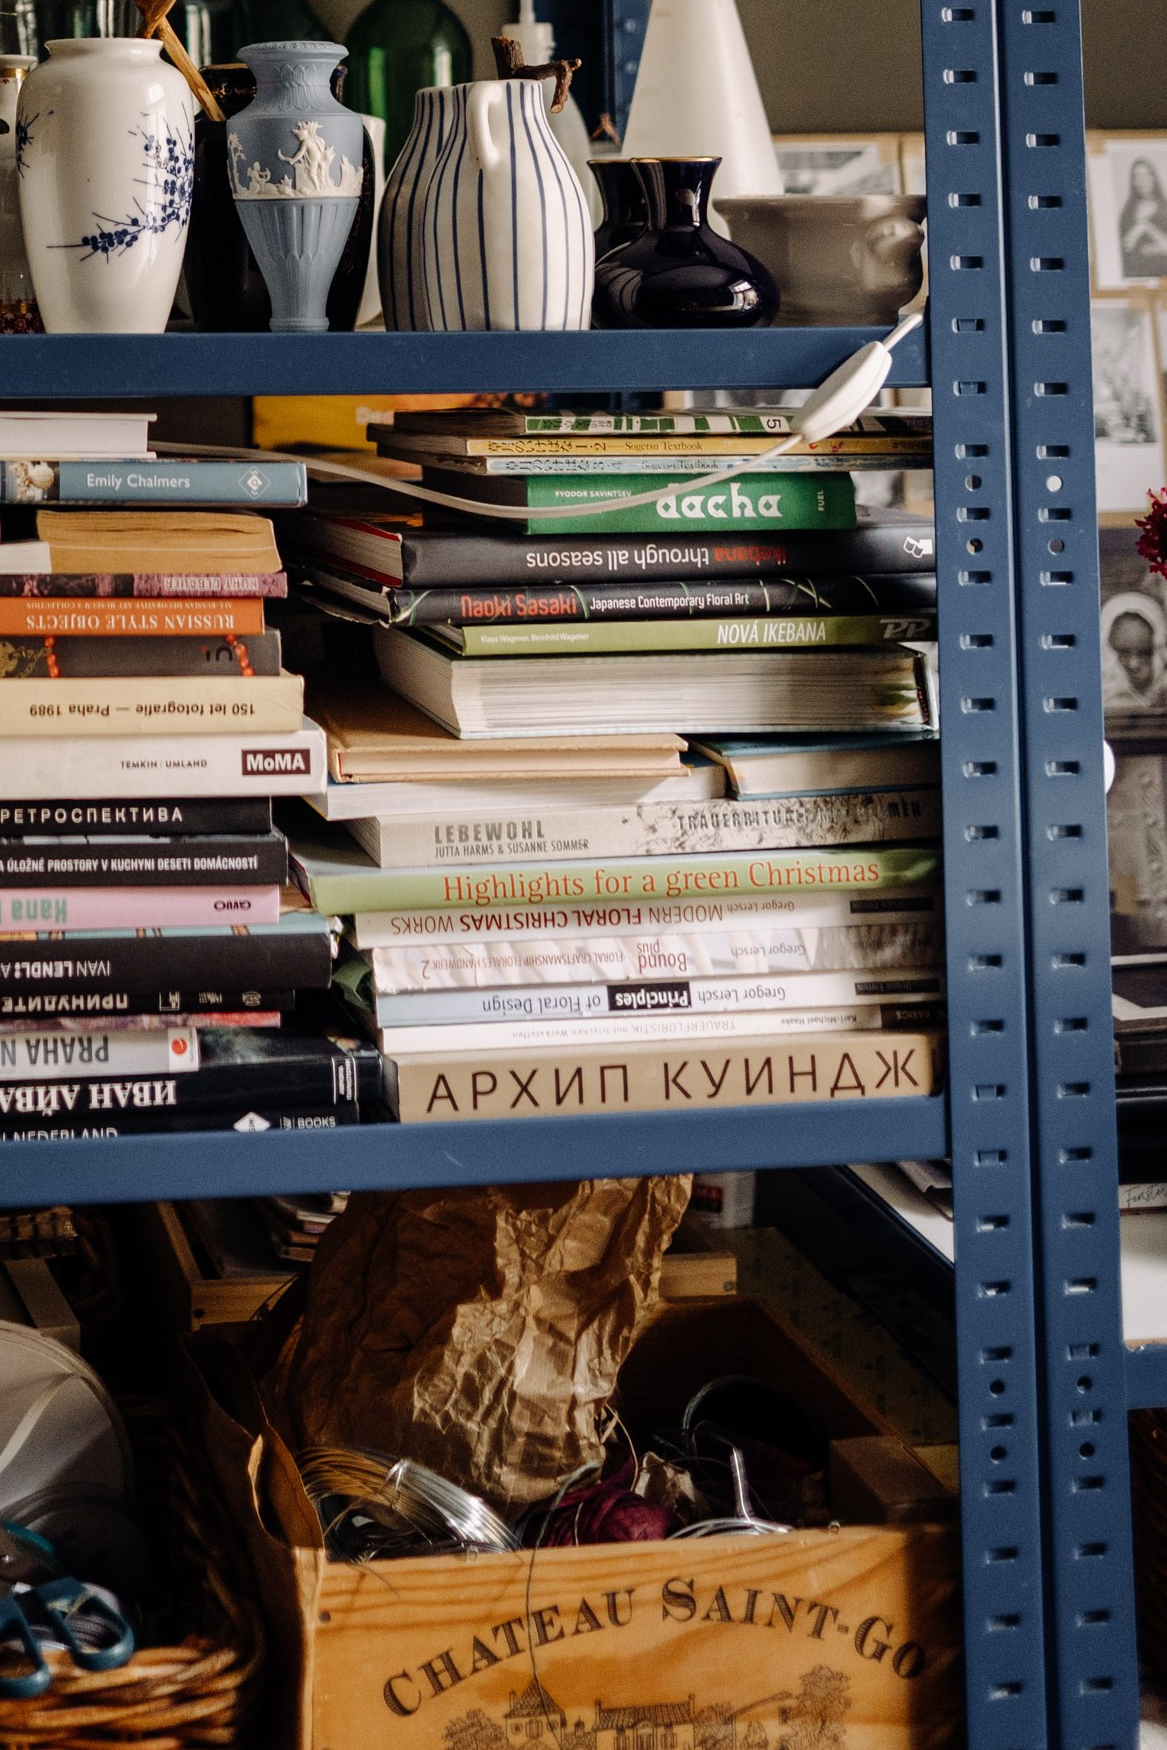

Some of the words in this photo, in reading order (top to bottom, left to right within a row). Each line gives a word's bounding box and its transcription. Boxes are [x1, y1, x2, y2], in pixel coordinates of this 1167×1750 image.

[766, 416, 782, 430] 5
[625, 440, 661, 453] Sogetsu
[665, 440, 703, 452] Textbook
[87, 472, 122, 490] Emily
[126, 472, 190, 488] Chalmers
[555, 490, 585, 498] FYODOR
[655, 482, 783, 519] dacha
[817, 490, 825, 511] FUEL
[526, 551, 603, 569] seasons
[606, 549, 630, 570] all
[634, 543, 709, 568] through
[26, 601, 76, 609] COLLECTION
[118, 601, 132, 609] ART
[135, 601, 183, 609] DECORATIVE
[184, 601, 213, 609] RUSSIAN
[461, 595, 511, 618] Naoki
[516, 593, 576, 616] Sasaki
[590, 595, 636, 612] Japanese
[638, 594, 704, 610] Contemporary
[707, 594, 732, 607] Floral
[734, 593, 749, 605] Art
[26, 613, 100, 629] OBJECTS
[105, 613, 158, 629] STYLE
[163, 613, 234, 629] RUSSIAN
[531, 634, 559, 642] Bernhild
[560, 634, 589, 643] Wagener
[717, 621, 759, 644] NOVÁ
[763, 622, 826, 643] IKEBANA
[29, 704, 62, 715] 1989
[69, 704, 110, 716] Praha
[135, 701, 204, 716] fotografie
[210, 704, 226, 716] let
[232, 704, 255, 715] 150
[120, 759, 161, 768] TEMKIN
[166, 759, 207, 768] UMLAND
[246, 754, 306, 772] MoMA
[0, 806, 183, 824] РЕТРОСПЕКТИВА
[434, 820, 544, 843] LEBEWOHL
[435, 844, 460, 858] JUTTA
[463, 843, 494, 856] HARMS
[498, 844, 504, 854] &
[508, 841, 548, 853] SUSANNE
[551, 839, 589, 852] SOMMER
[7, 856, 44, 872] ÚLOŽNÉ
[48, 859, 98, 871] PROSTORY
[102, 859, 108, 871] V
[111, 858, 155, 871] KUCHYNI
[157, 858, 190, 870] DESETI
[194, 855, 258, 870] DOMÁCNOSTÍ
[443, 871, 585, 905] Highlights
[595, 869, 631, 896] for
[642, 876, 656, 893] a
[666, 871, 738, 897] green
[748, 859, 880, 889] Christmas
[11, 899, 67, 925] Hana
[727, 902, 758, 913] Lersch
[761, 900, 795, 911] Gregor
[460, 910, 568, 932] CHRISTMAS
[571, 907, 642, 927] FLORAL
[649, 904, 723, 924] MODERN
[391, 915, 454, 935] WORKS
[636, 939, 660, 956] plus
[730, 946, 765, 958] Lersch
[769, 943, 806, 955] Gregor
[432, 958, 480, 969] HANDWERK
[482, 956, 521, 967] FLORALES
[523, 953, 592, 966] CRAFTSMANSHIP
[594, 952, 623, 963] FLORAL
[638, 953, 687, 974] Bound
[77, 960, 110, 977] IVAN
[421, 960, 430, 979] 2
[615, 988, 689, 1007] Principles
[698, 989, 738, 1003] Lersch
[744, 985, 786, 1000] Gregor
[482, 996, 533, 1014] Design
[537, 996, 581, 1013] Floral
[585, 995, 601, 1009] of
[632, 1019, 735, 1034] TRAUERFLORISTIK
[781, 1017, 805, 1026] Haake
[807, 1015, 857, 1025] Karl-Michael
[512, 1029, 568, 1039] Werkstoffen
[572, 1027, 610, 1037] frischen
[614, 1026, 628, 1035] mit
[25, 1035, 110, 1066] PRAHA
[89, 1080, 176, 1109] ИВАН
[426, 1063, 630, 1113] АРХИП
[298, 1116, 335, 1129] BOOKS
[382, 1587, 636, 1719] CHATEAU
